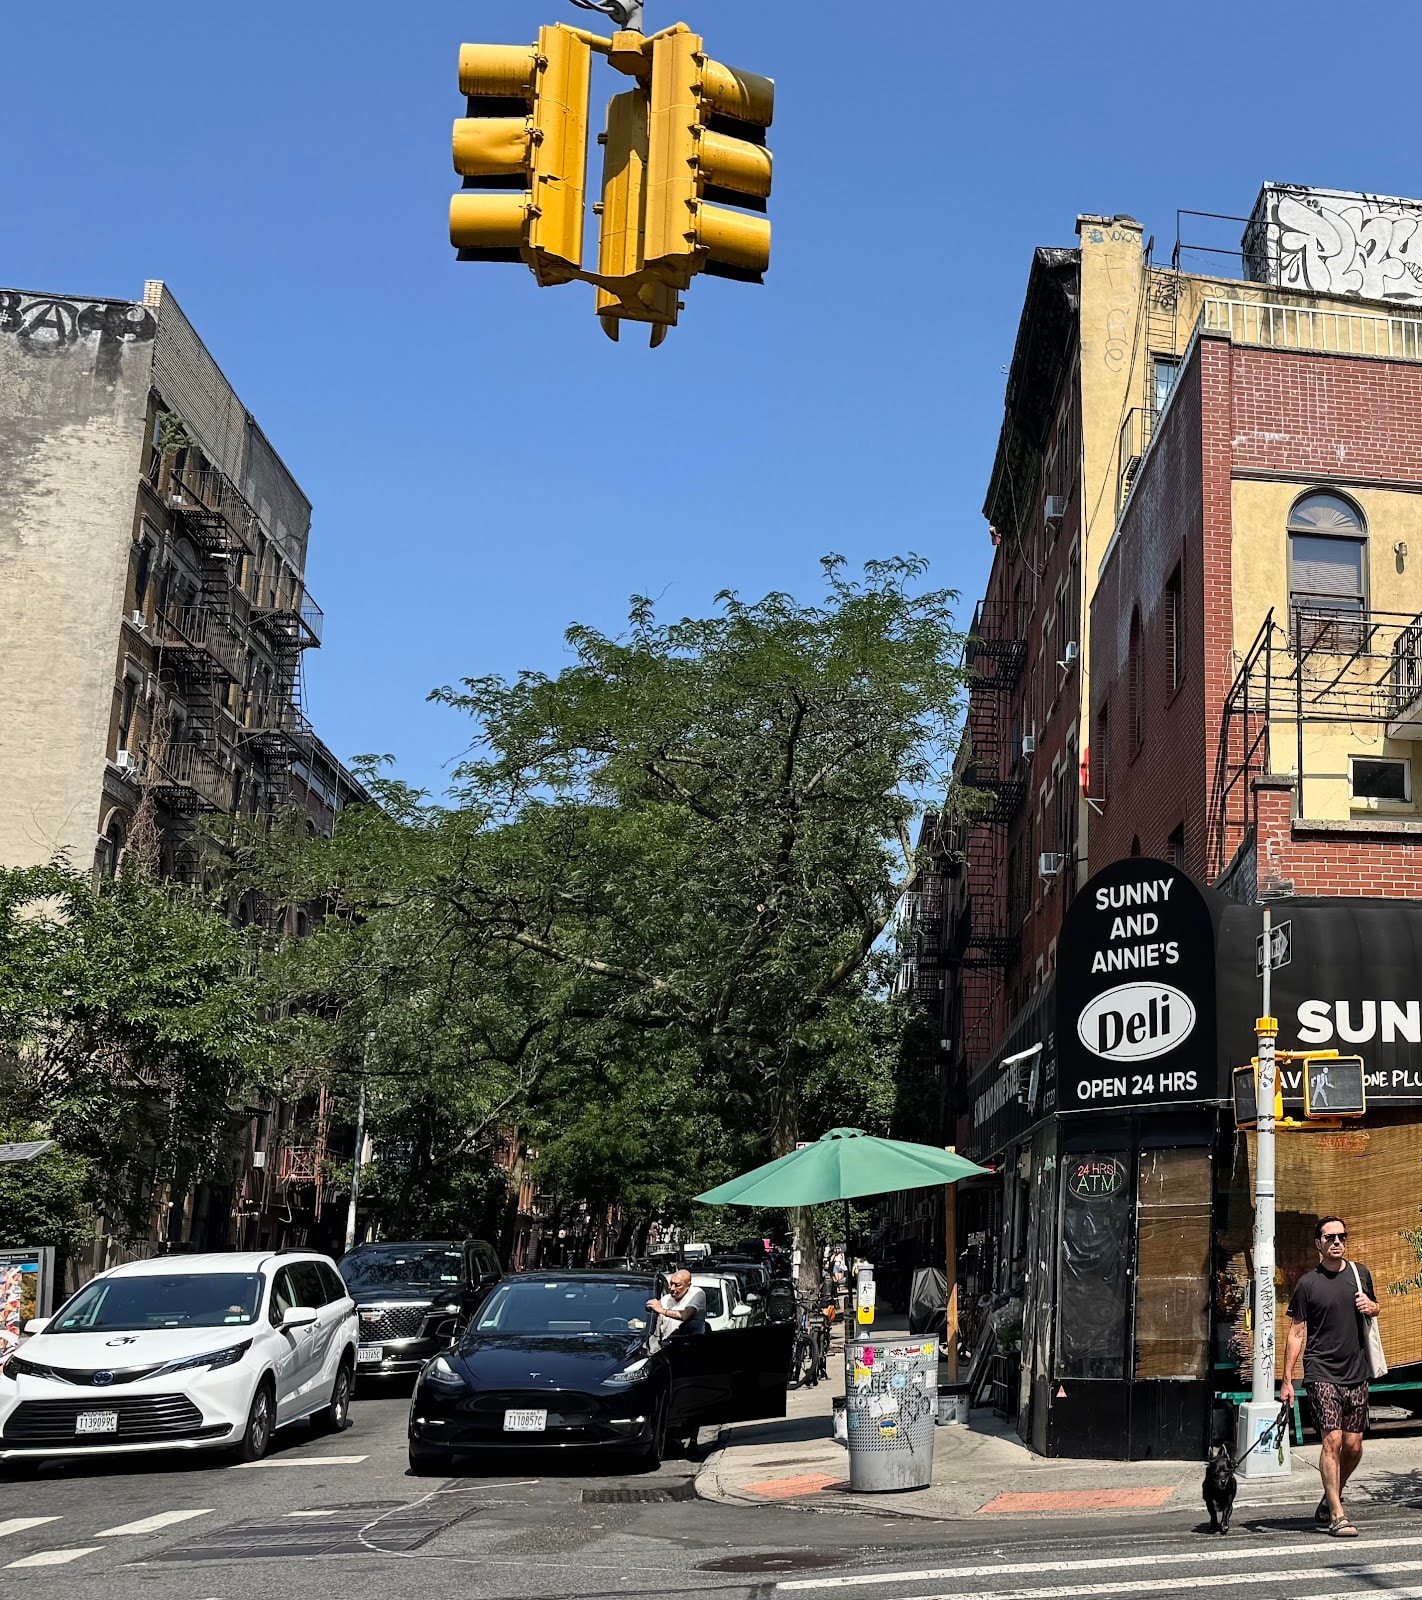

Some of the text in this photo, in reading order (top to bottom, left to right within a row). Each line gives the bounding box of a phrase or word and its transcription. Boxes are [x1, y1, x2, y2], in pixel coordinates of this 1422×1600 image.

[1095, 878, 1174, 911] SUNNY
[1109, 913, 1159, 940] AND
[1090, 941, 1179, 974] ANNIE'S
[1098, 993, 1171, 1054] Deli
[1077, 1071, 1198, 1100] OPEN 24 HRS
[1077, 1163, 1114, 1177] 24 HRS
[1077, 1175, 1115, 1193] ATM
[80, 1417, 115, 1428] T139099C
[508, 1416, 543, 1426] T110857C
